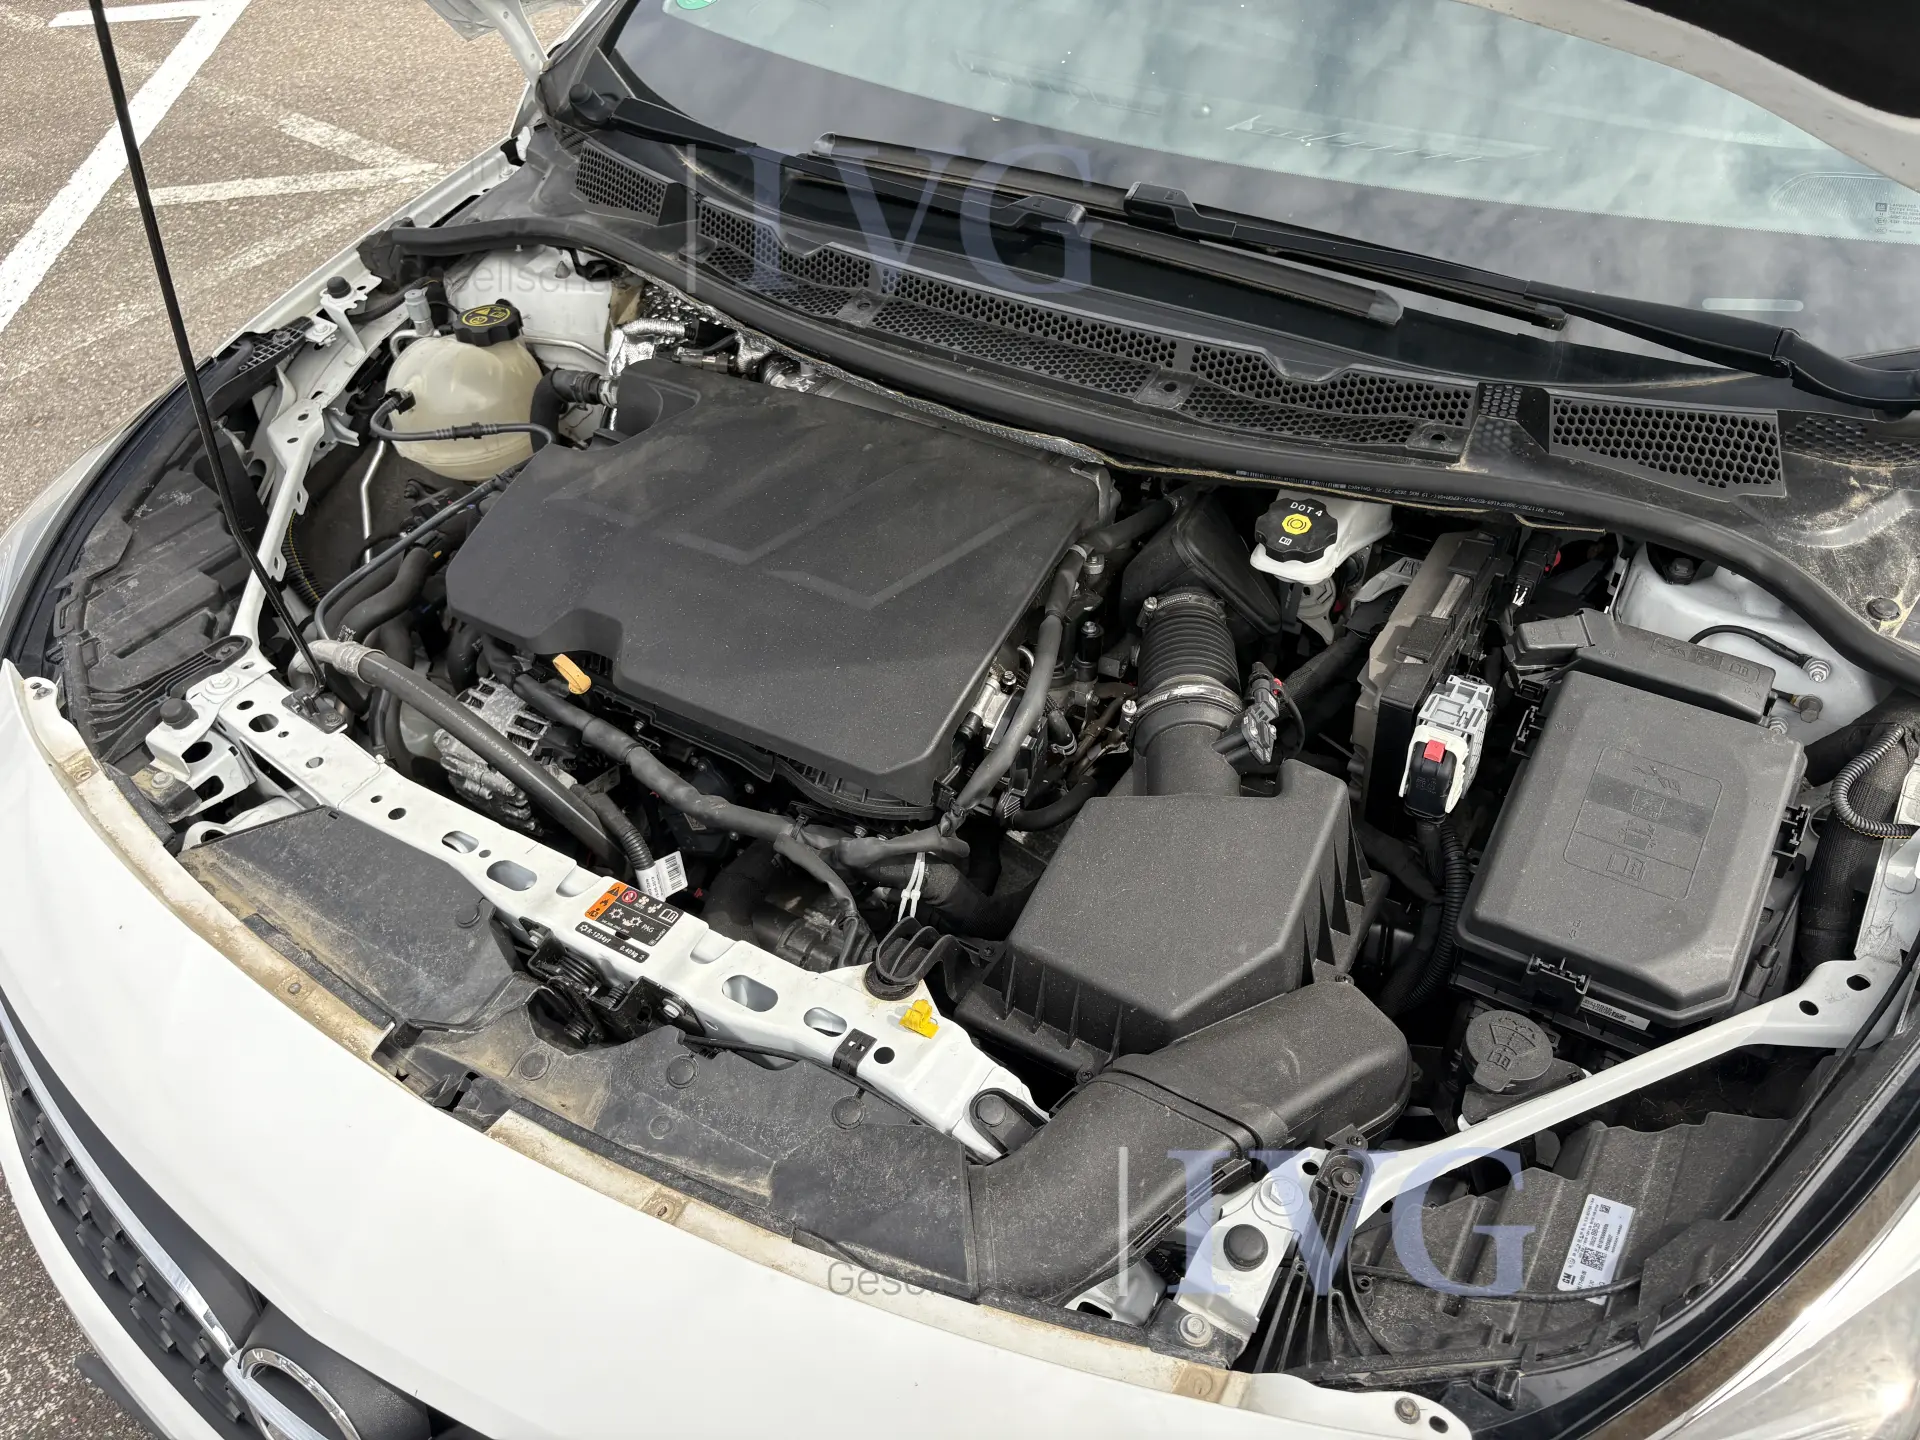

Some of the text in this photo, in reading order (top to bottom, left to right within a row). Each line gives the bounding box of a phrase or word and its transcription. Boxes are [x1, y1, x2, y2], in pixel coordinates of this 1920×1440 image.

[1290, 501, 1314, 514] DOT
[641, 923, 655, 933] PAG
[1562, 1272, 1573, 1285] GM
